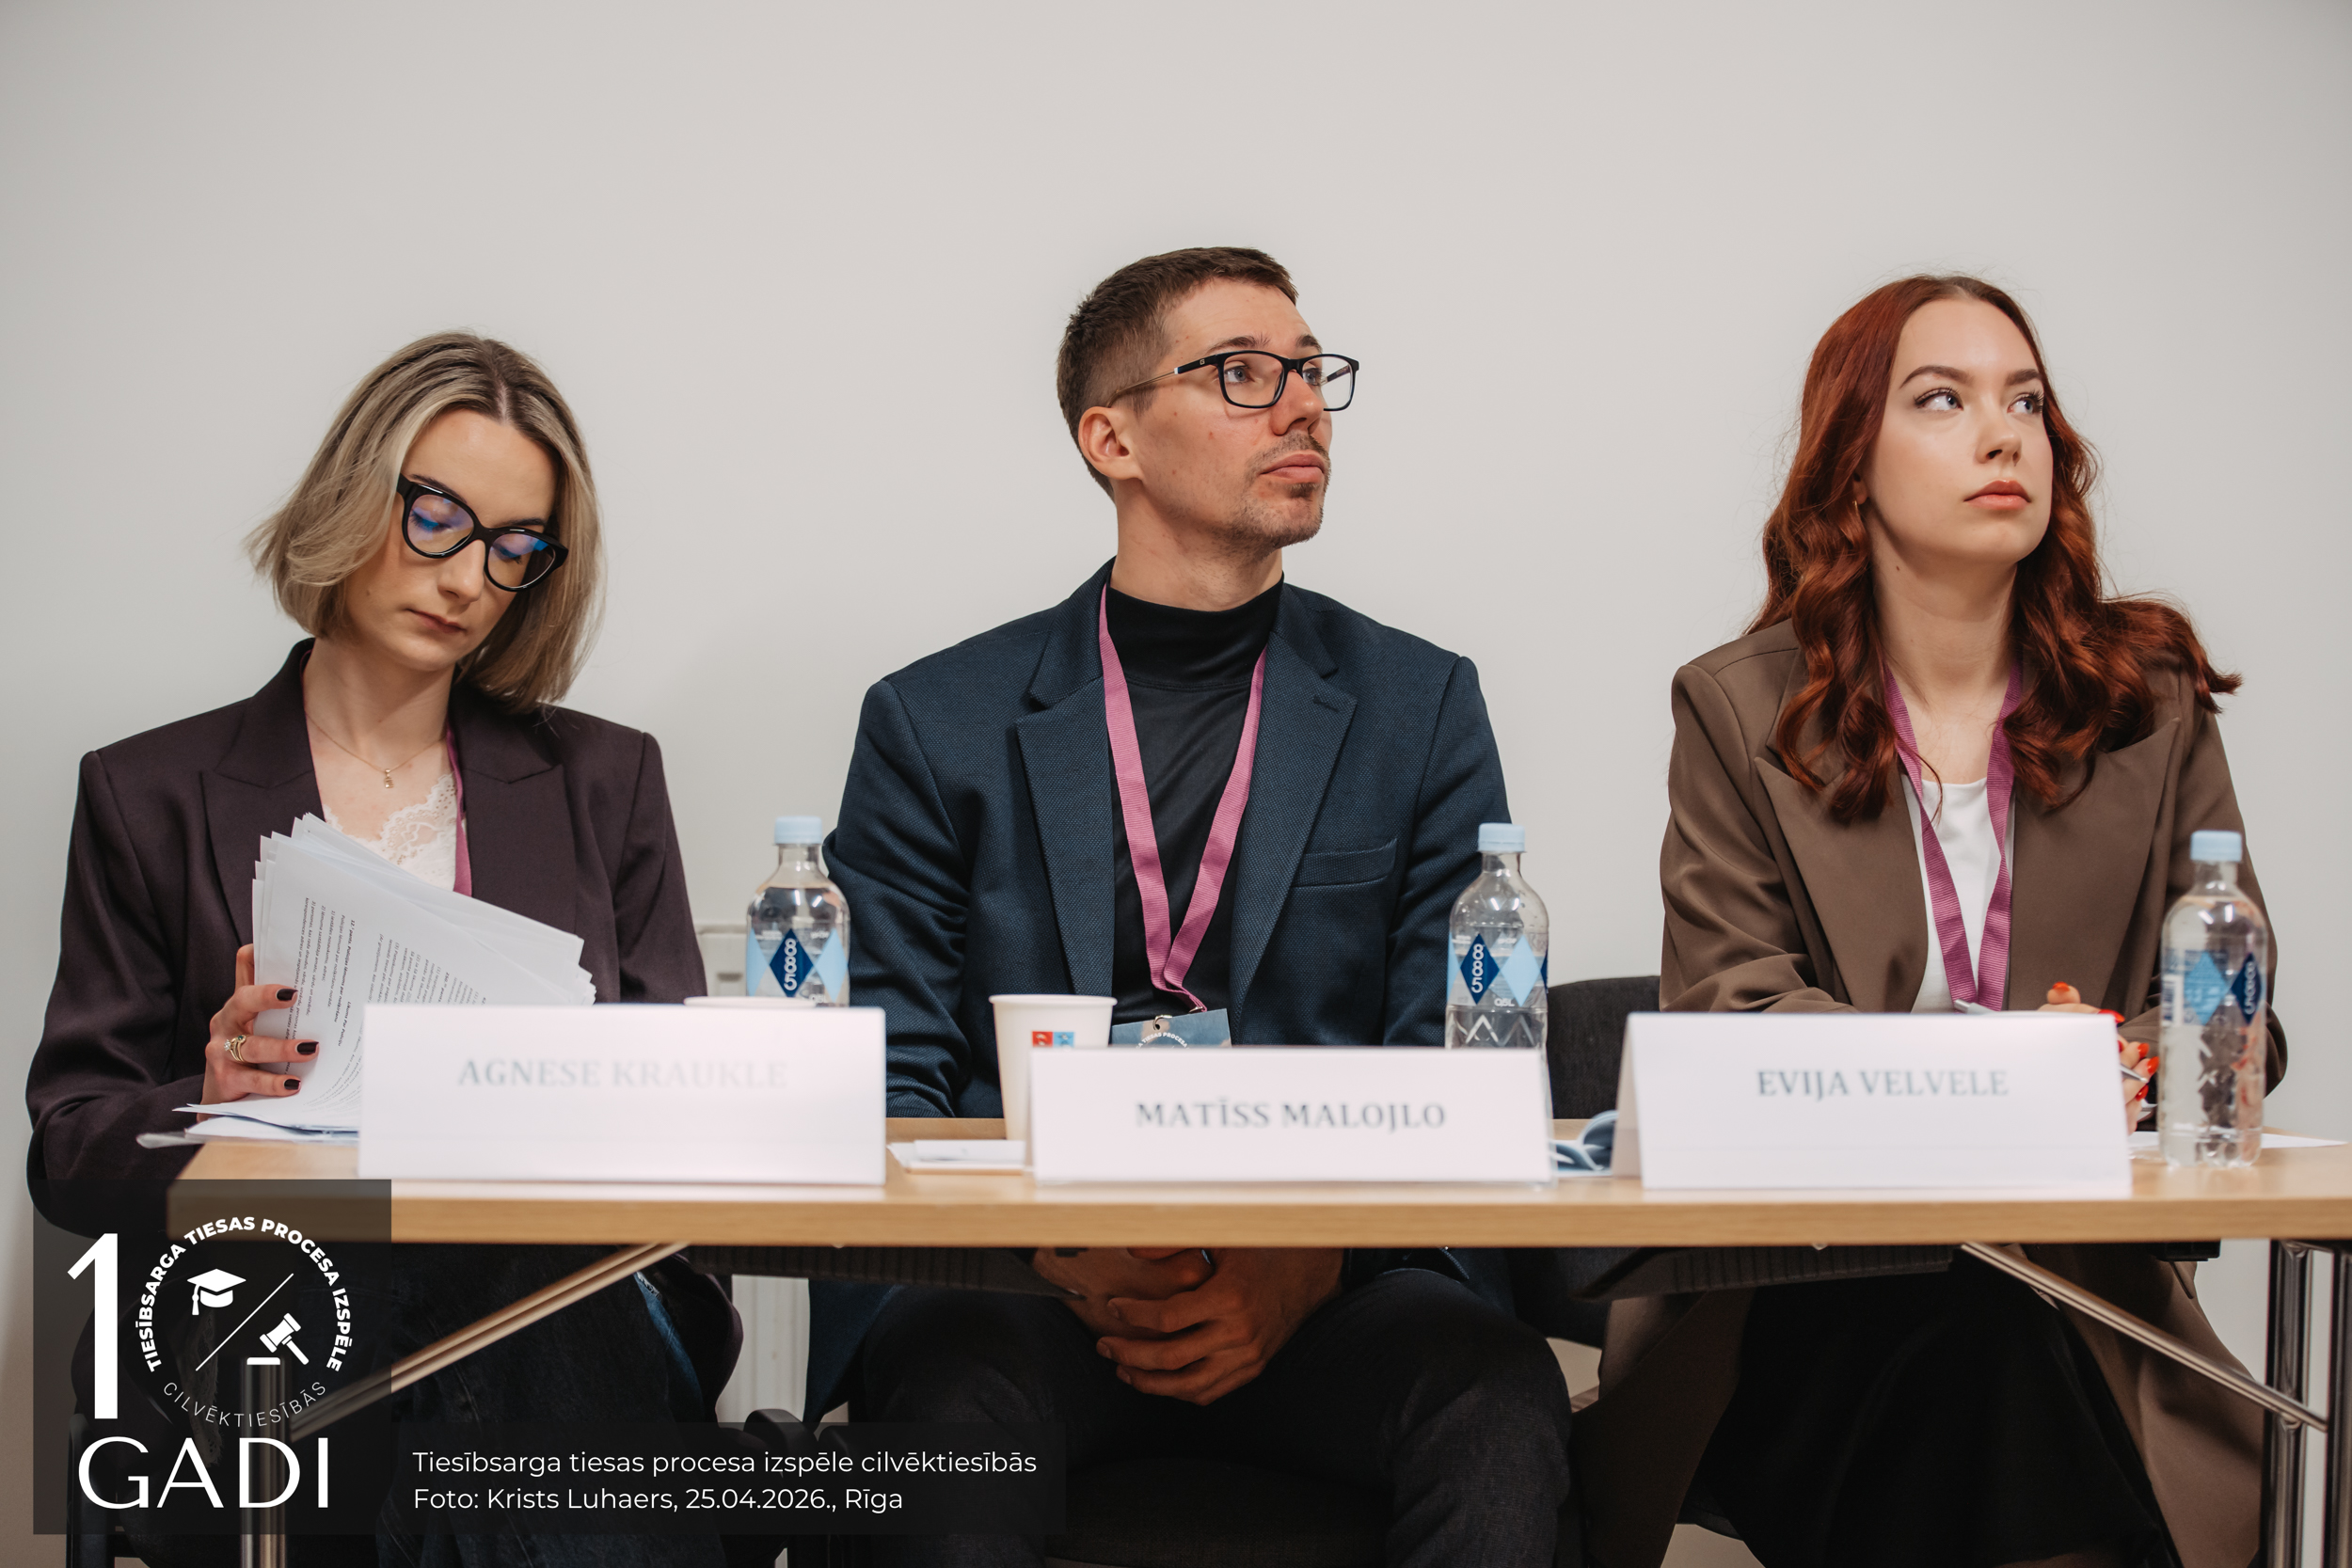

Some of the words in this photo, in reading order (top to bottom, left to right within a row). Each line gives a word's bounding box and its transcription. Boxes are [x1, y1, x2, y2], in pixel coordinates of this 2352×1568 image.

[298, 950, 302, 958] un
[784, 938, 798, 991] 885
[1470, 943, 1485, 993] 885
[309, 988, 313, 996] un
[334, 995, 342, 1022] nošķiršanu
[1141, 1032, 1163, 1043] TIESAS
[456, 1058, 602, 1088] AGNESE
[612, 1060, 788, 1089] KRAUKLE
[1756, 1069, 1850, 1101] EVIJA
[1858, 1069, 2009, 1096] VELVELE
[1136, 1099, 1271, 1128] MATĪSS
[1282, 1102, 1446, 1133] MALOJLO
